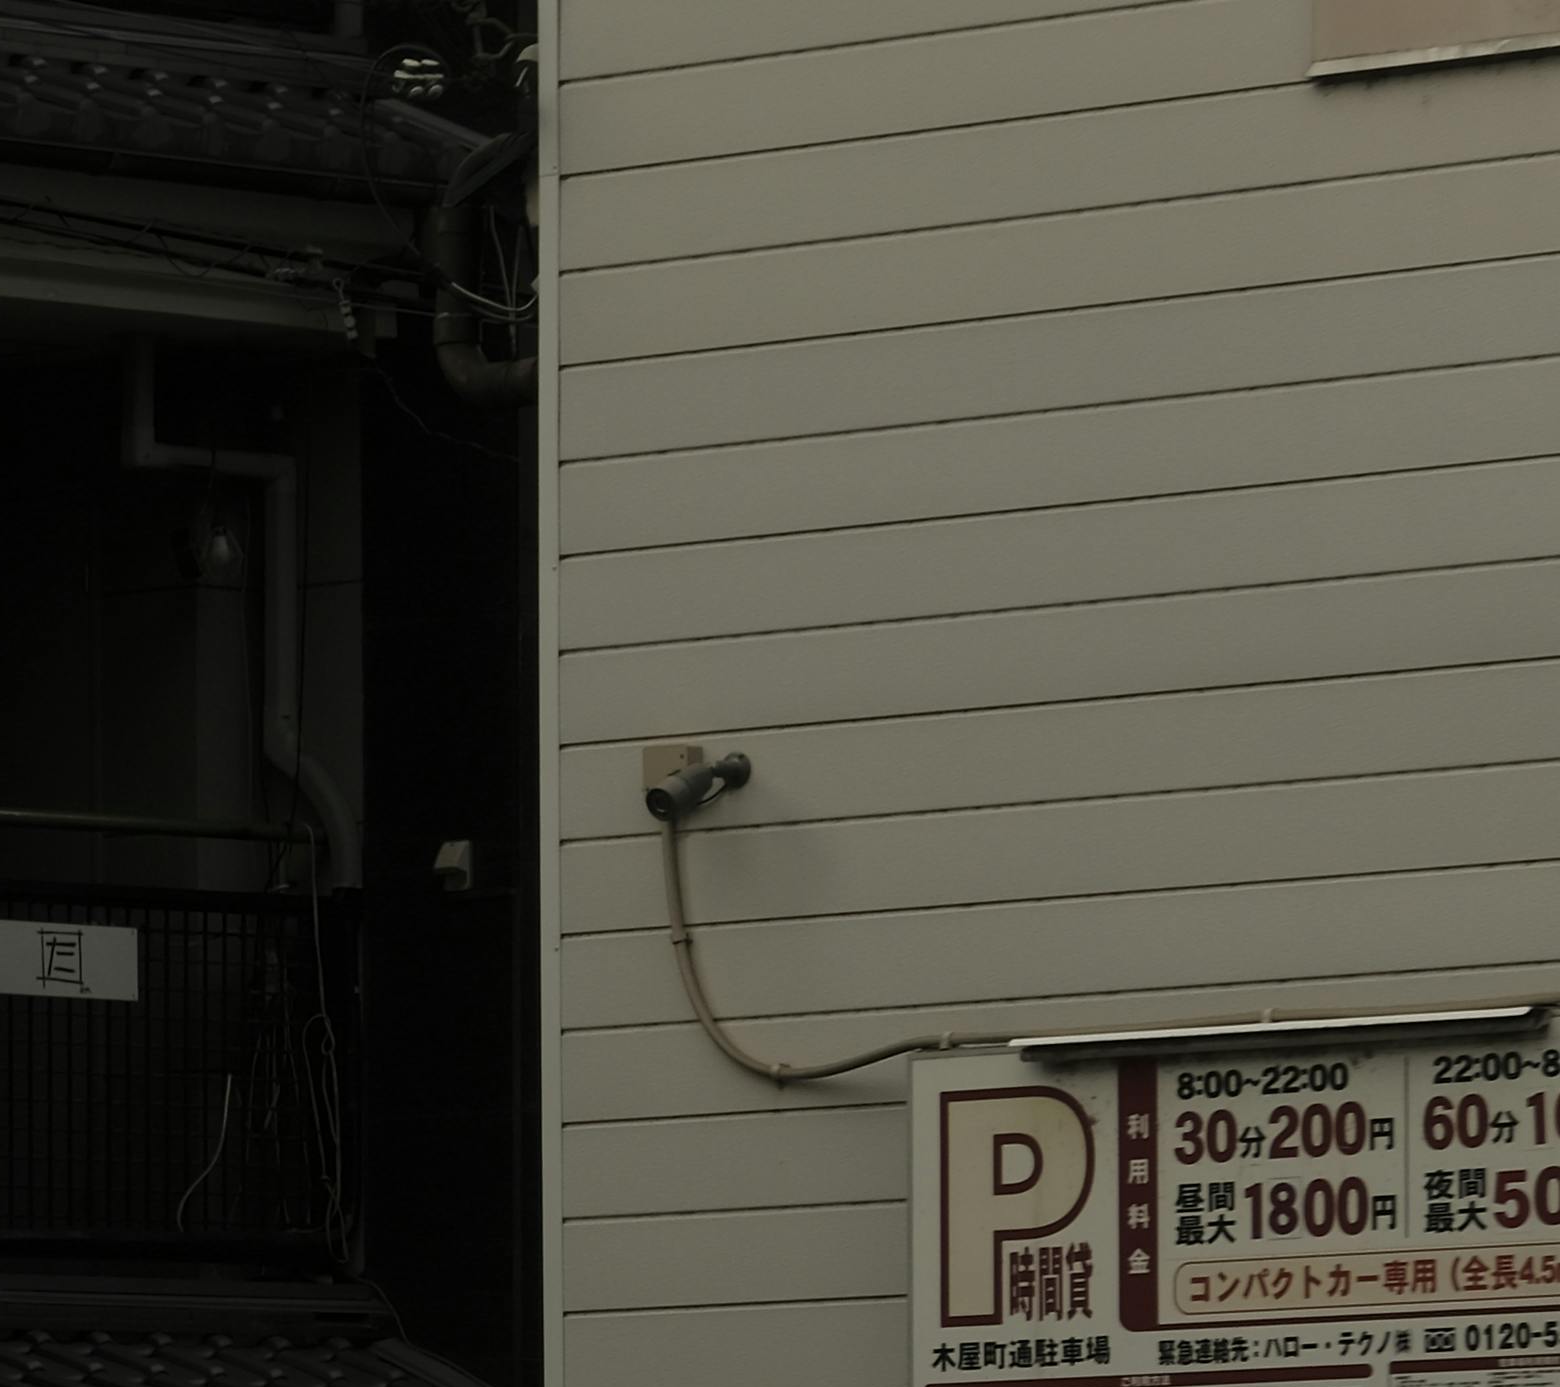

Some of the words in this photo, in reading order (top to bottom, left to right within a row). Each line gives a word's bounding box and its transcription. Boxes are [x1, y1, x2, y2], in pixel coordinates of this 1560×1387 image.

[940, 1085, 1095, 1328] P
[1127, 1113, 1151, 1275] 利用料金
[1009, 1242, 1093, 1323] 時間貸
[932, 1335, 1111, 1372] 木屋町通駐車場
